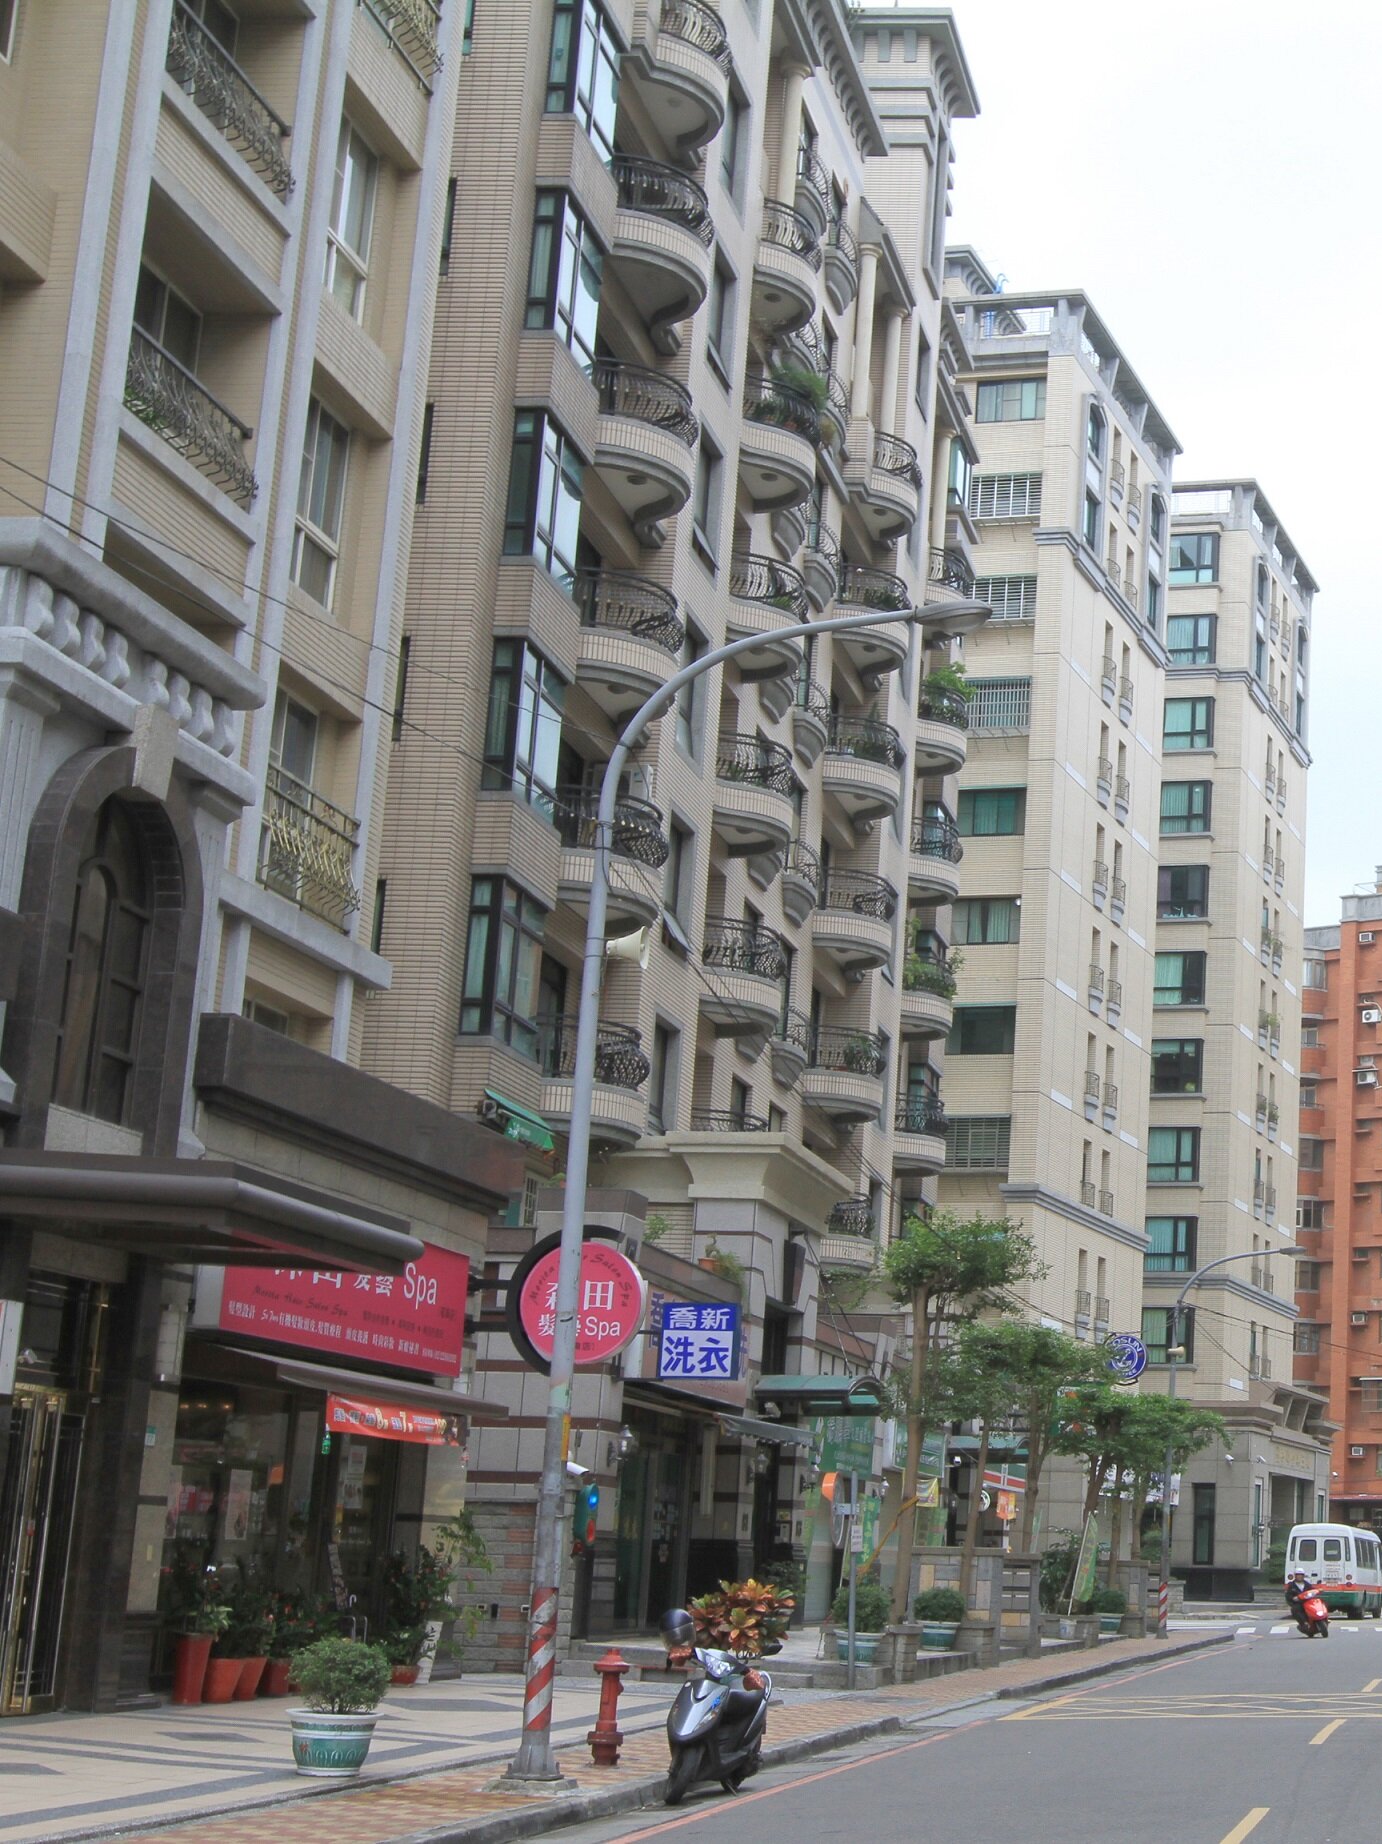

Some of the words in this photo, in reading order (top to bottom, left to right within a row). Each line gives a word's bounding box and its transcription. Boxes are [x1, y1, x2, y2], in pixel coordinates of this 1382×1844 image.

[404, 1262, 438, 1310] Spa
[585, 1316, 621, 1341] Spa
[668, 1306, 732, 1330] 喬新
[662, 1335, 730, 1374] 洗衣
